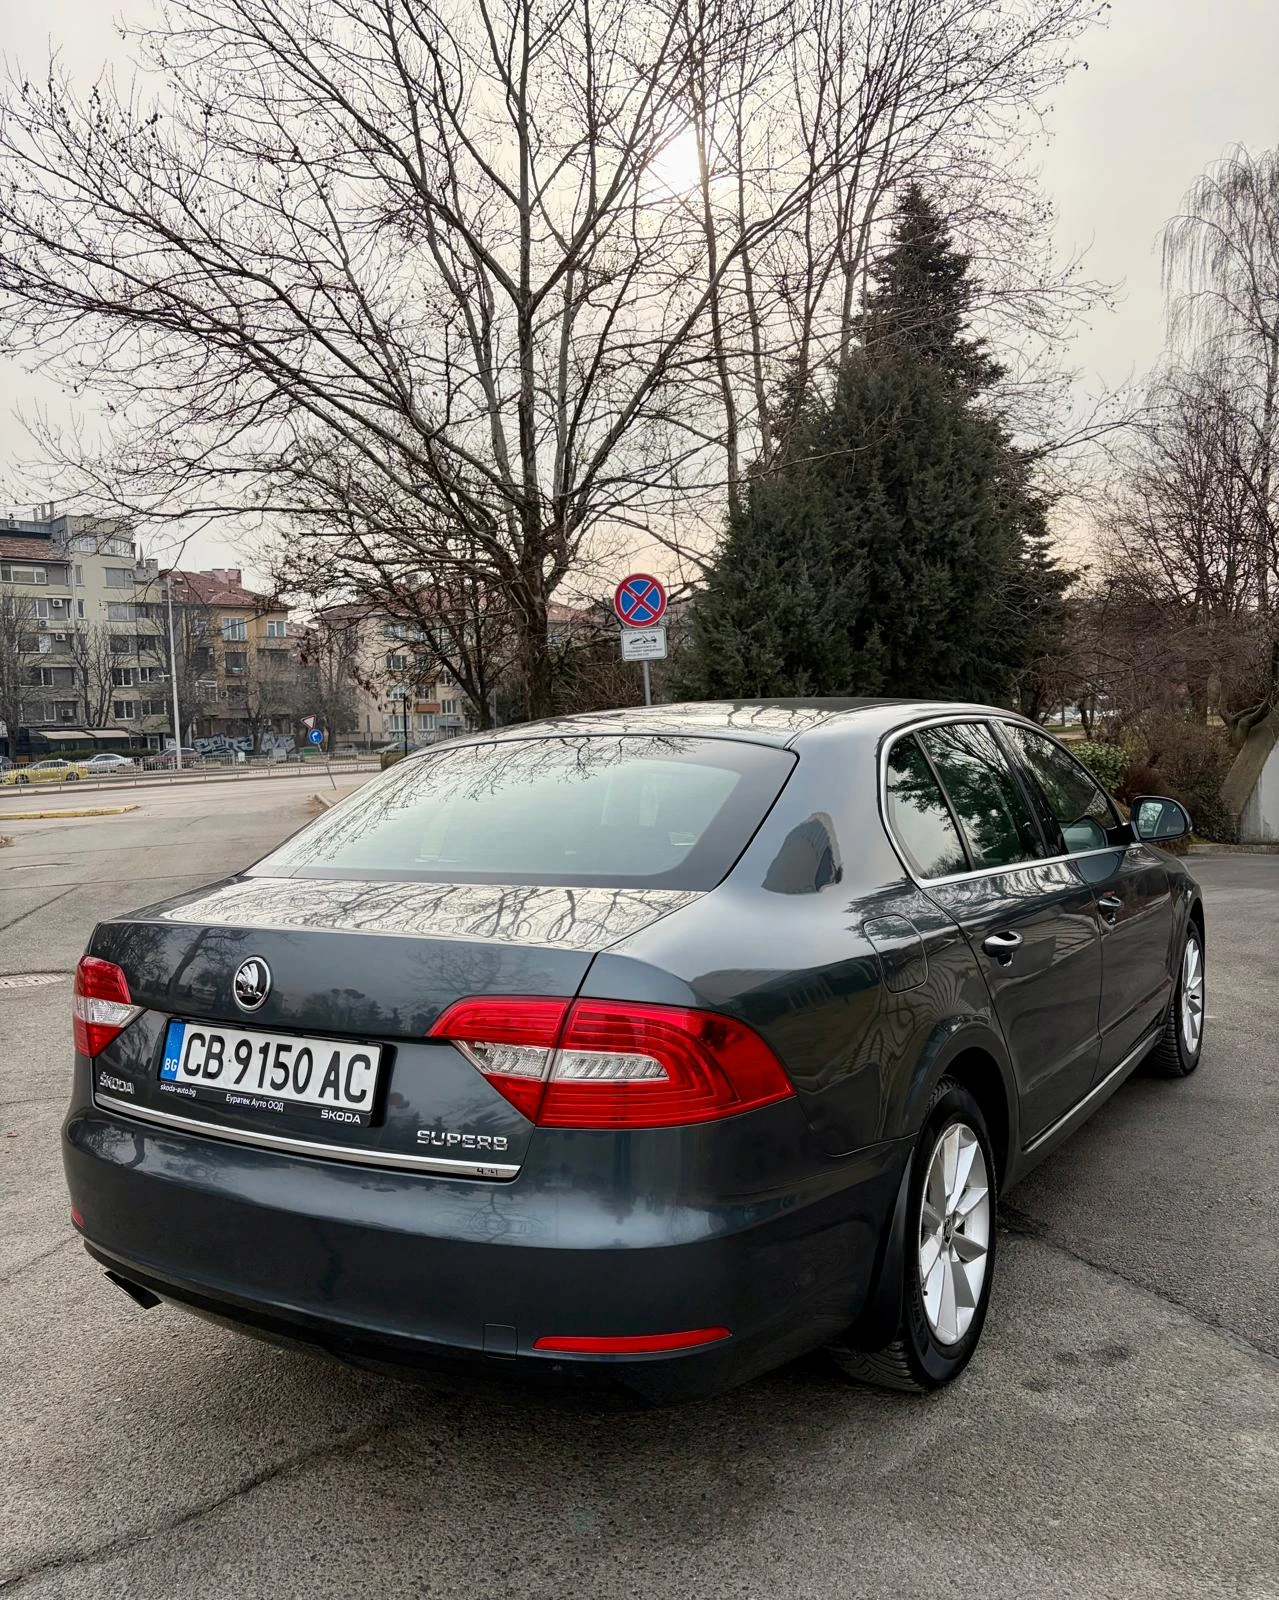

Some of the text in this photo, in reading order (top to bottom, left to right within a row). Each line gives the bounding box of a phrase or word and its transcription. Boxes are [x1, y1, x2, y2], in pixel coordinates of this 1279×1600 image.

[164, 1058, 178, 1072] BG
[182, 1032, 371, 1103] CB 9150 AC
[160, 1084, 197, 1098] skoda-auto.bg
[250, 1098, 266, 1109] Ауто
[267, 1102, 284, 1112] ООД
[320, 1109, 361, 1124] SKODA
[416, 1130, 508, 1151] SUPERB
